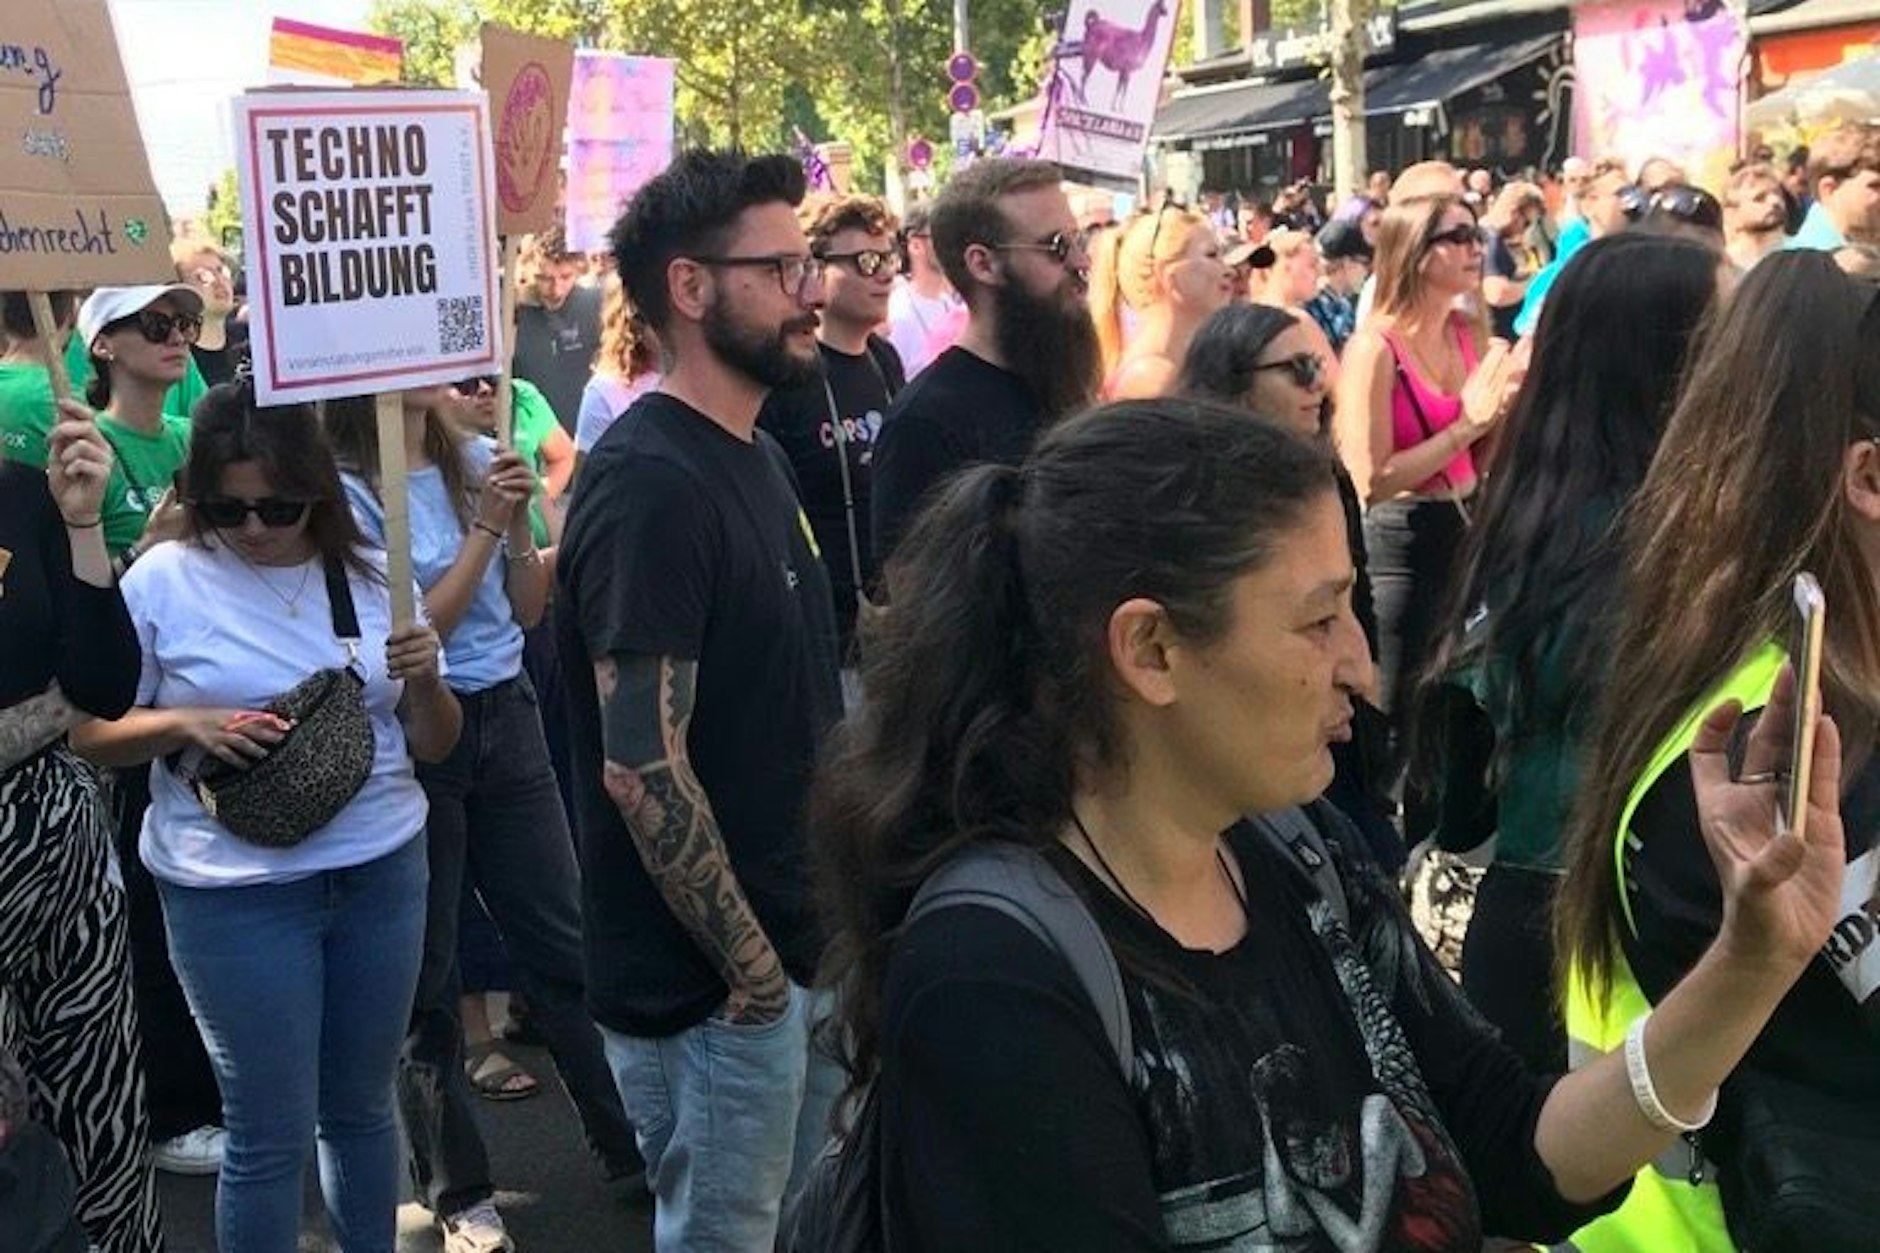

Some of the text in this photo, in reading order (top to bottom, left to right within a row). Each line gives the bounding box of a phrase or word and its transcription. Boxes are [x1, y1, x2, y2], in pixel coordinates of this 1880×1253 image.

[267, 124, 427, 183] TECHNO
[273, 184, 433, 245] SCHAFFT
[280, 243, 437, 306] BILDUNG
